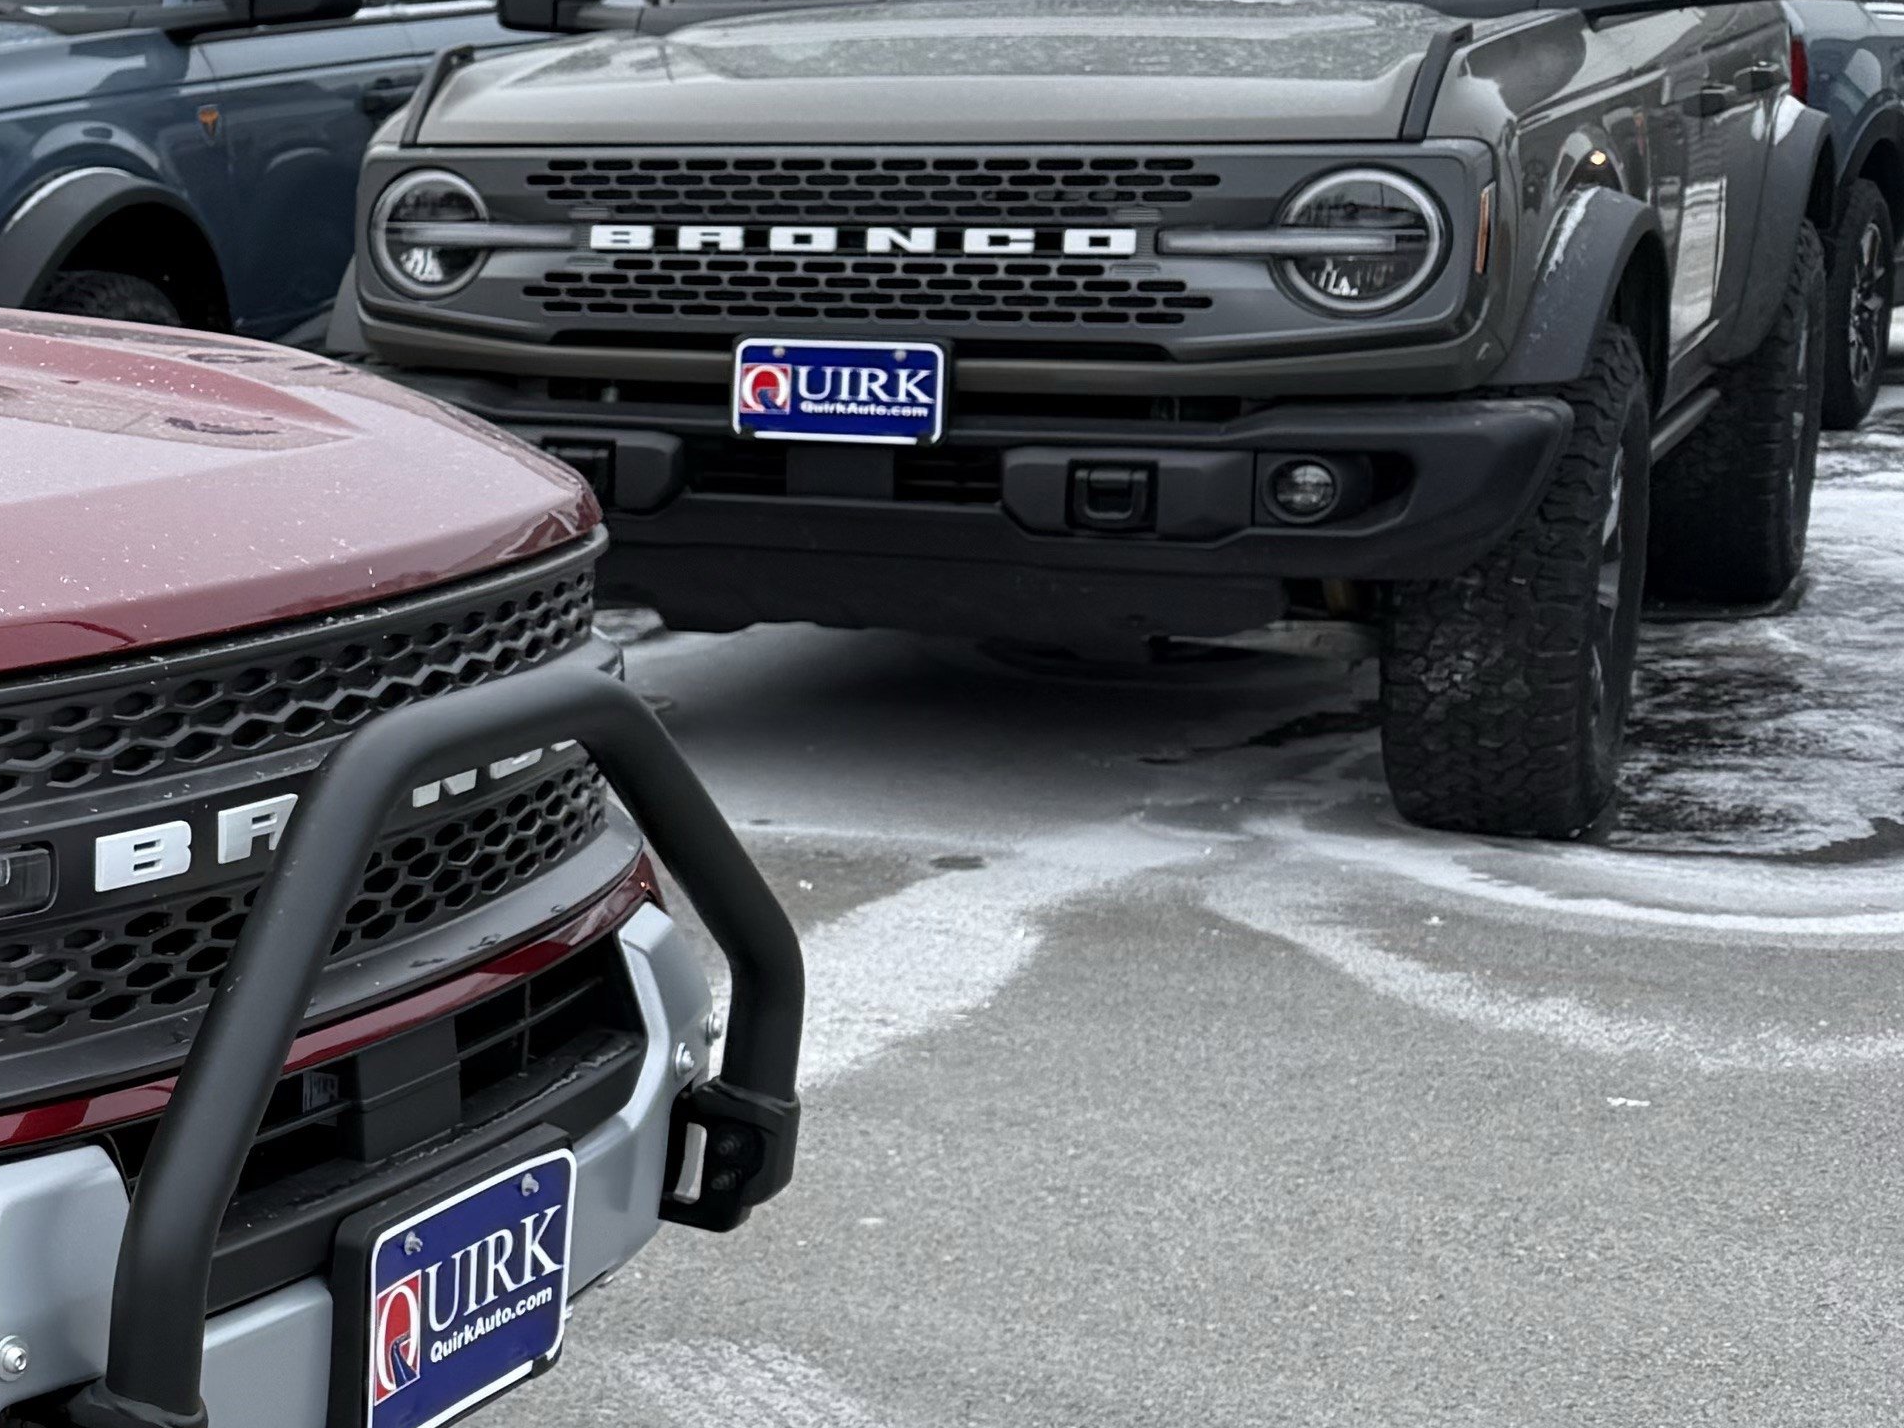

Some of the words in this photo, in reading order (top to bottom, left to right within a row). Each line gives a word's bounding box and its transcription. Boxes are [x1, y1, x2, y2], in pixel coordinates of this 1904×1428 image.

[591, 225, 1136, 255] BRONCO
[741, 363, 935, 414] QUIRK
[800, 401, 929, 418] QuirkAuto.com
[376, 1203, 564, 1392] QUIRK
[430, 1285, 554, 1364] QuirkAuto.com
